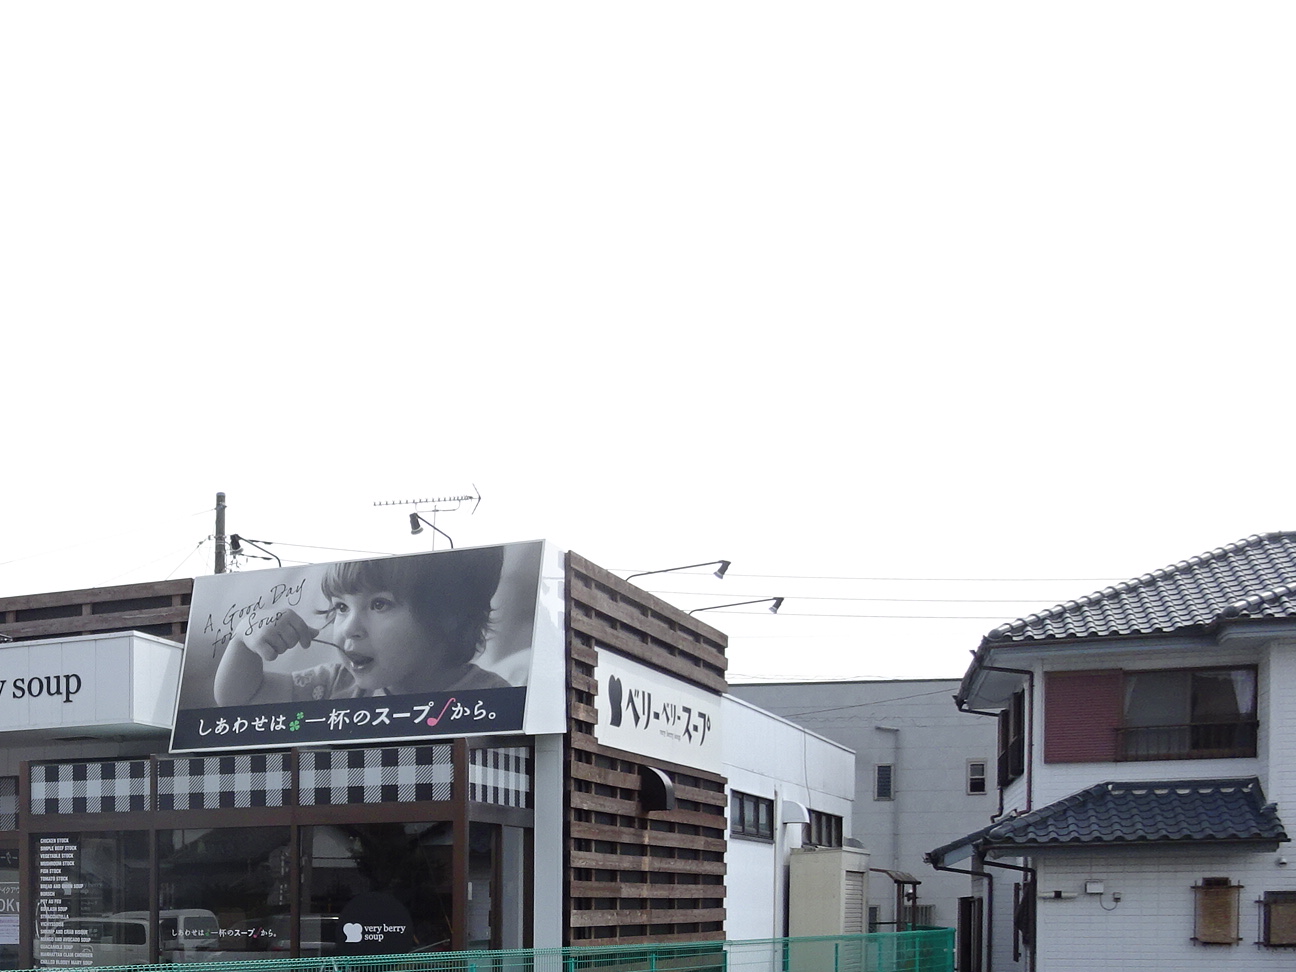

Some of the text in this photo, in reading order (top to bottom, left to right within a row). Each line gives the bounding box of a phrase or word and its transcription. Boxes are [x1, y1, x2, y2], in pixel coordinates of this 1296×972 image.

[204, 578, 306, 634] A Good Day
[211, 611, 287, 659] for Soup
[11, 672, 83, 704] soup
[364, 923, 406, 934] very berry
[364, 933, 384, 942] soup
